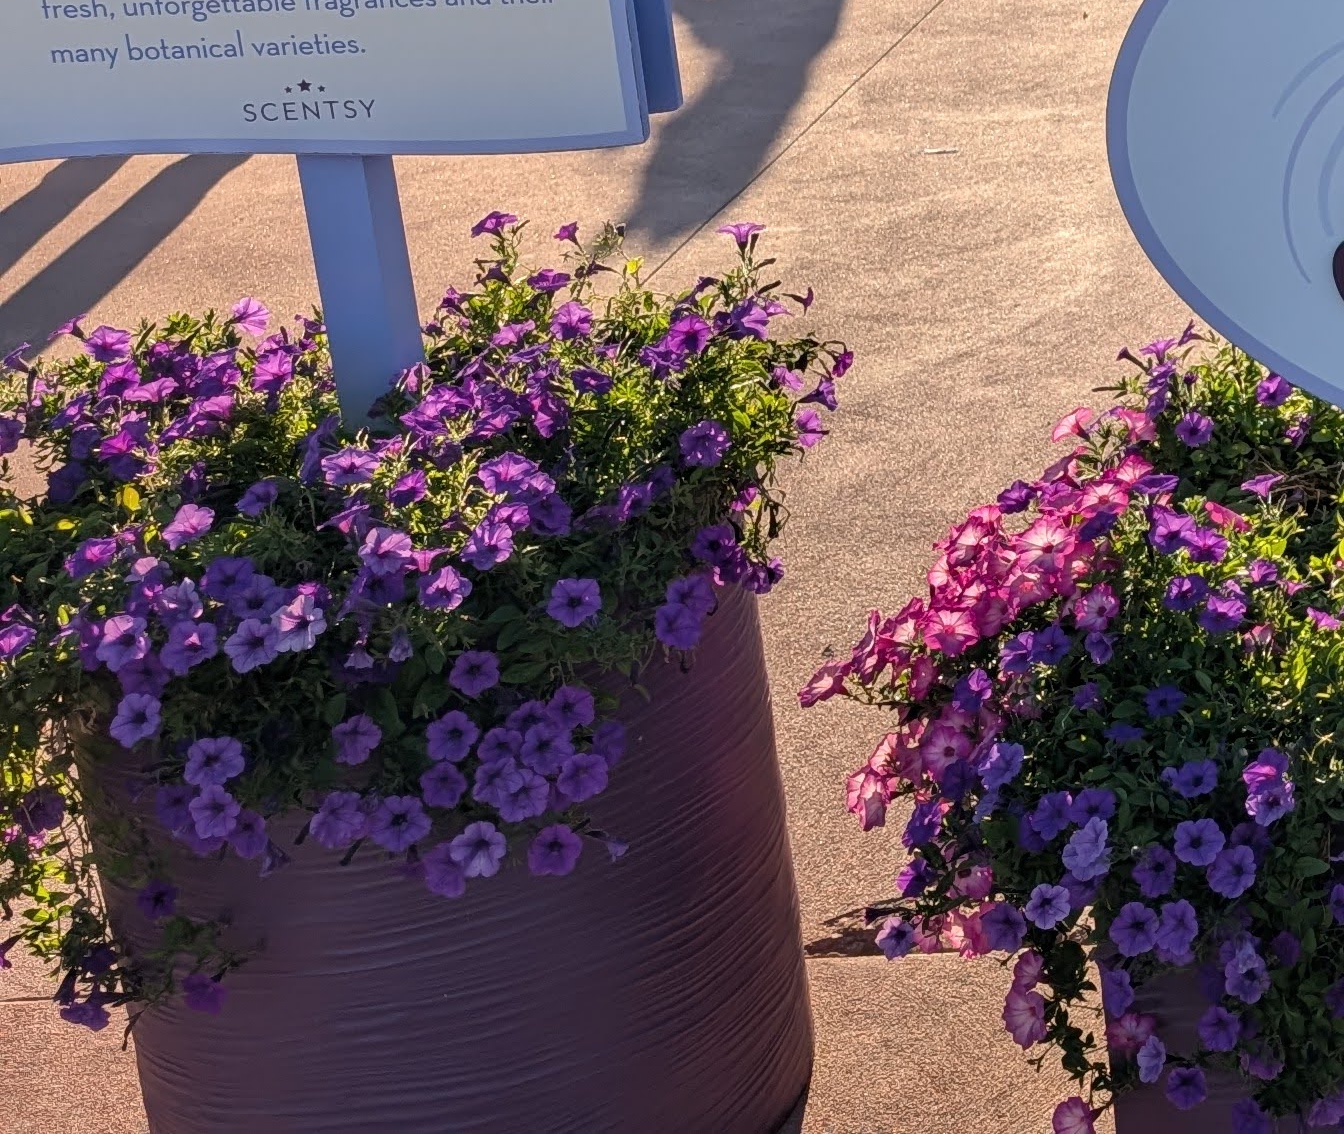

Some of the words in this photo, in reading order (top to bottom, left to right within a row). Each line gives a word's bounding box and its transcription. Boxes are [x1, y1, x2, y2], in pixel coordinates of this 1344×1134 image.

[50, 47, 119, 70] many
[124, 29, 244, 61] botanical
[251, 33, 366, 57] varieties.
[243, 99, 375, 123] SCENTSY
